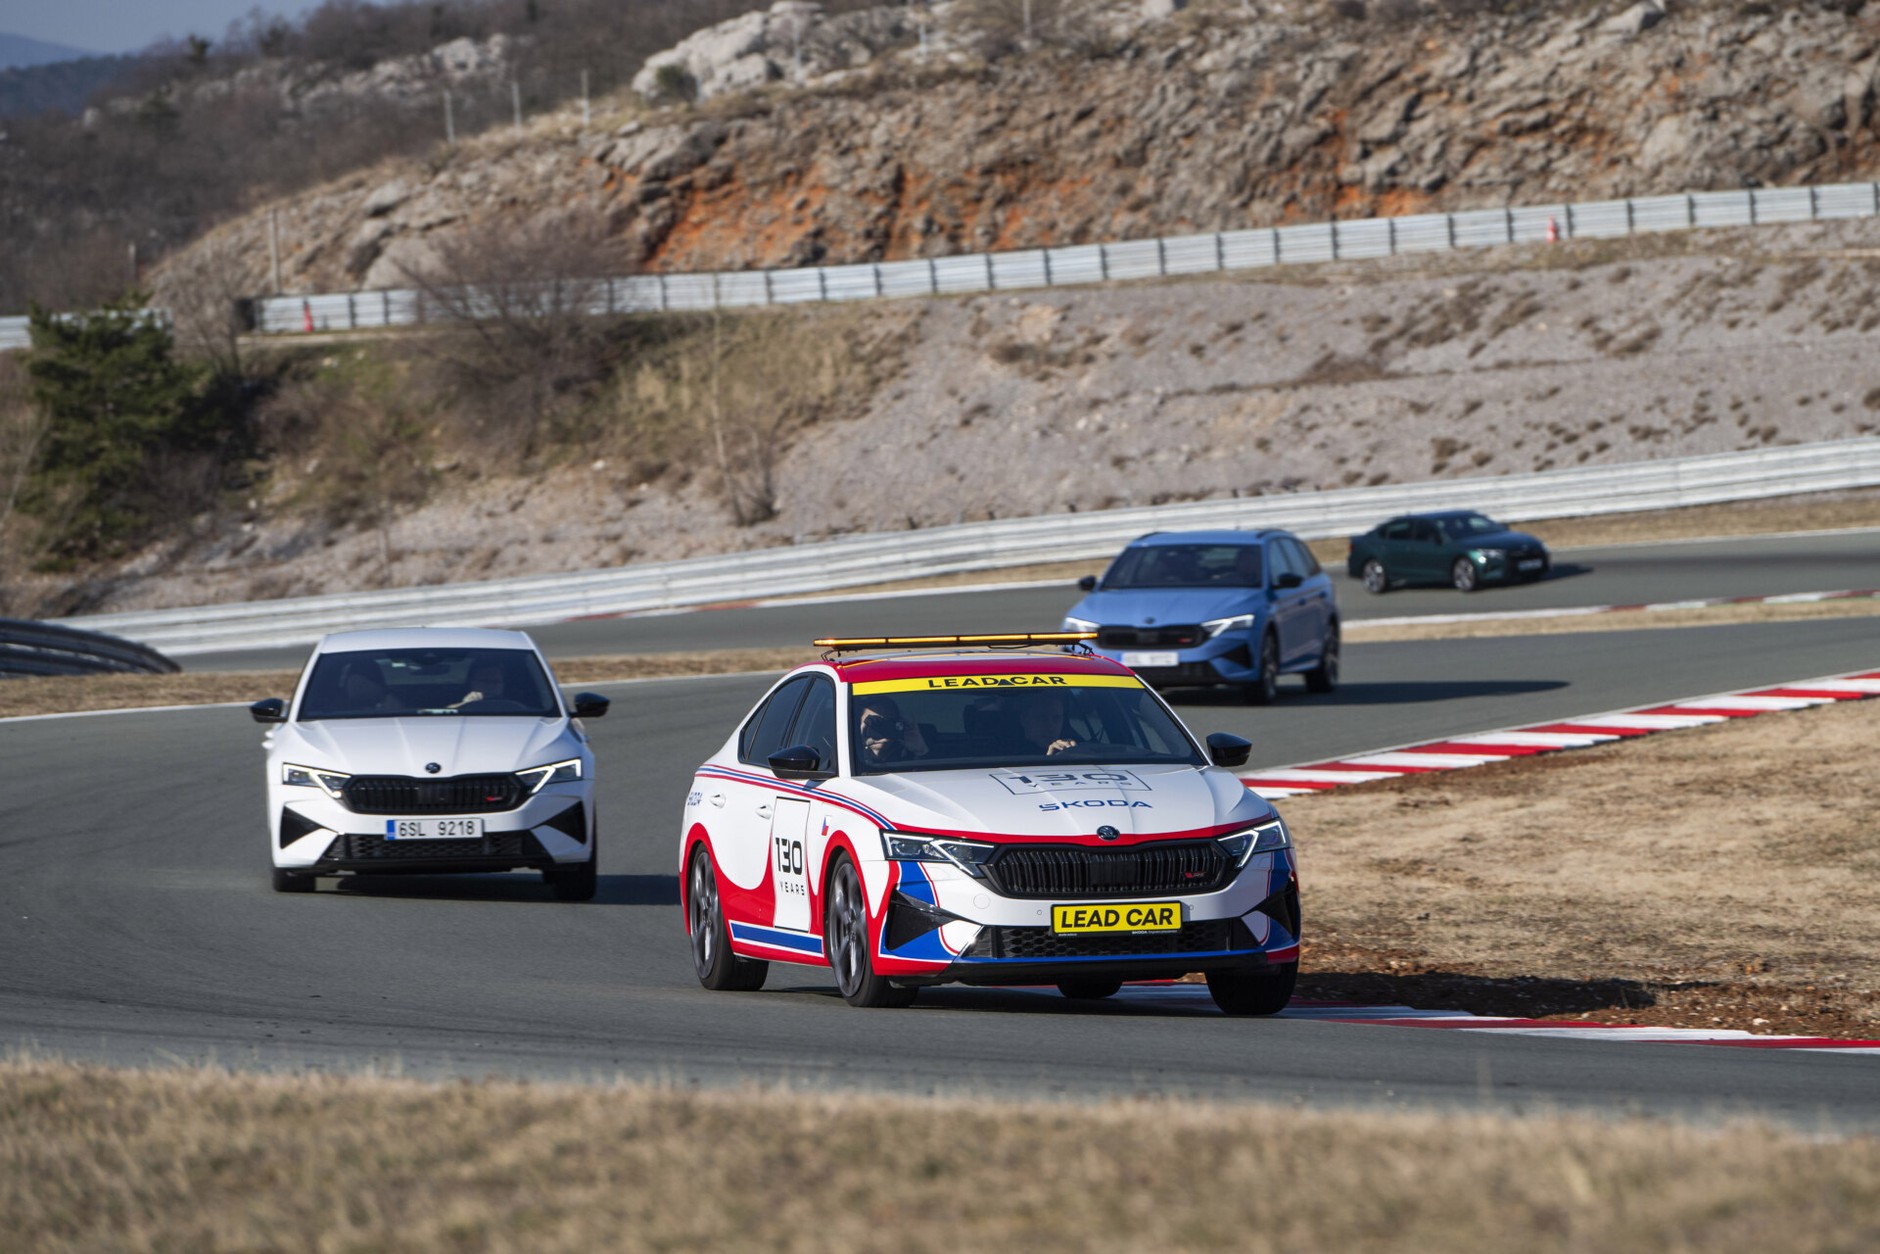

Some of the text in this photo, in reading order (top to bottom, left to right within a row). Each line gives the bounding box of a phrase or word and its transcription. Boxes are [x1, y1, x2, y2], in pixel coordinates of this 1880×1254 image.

[928, 676, 1067, 688] LEAD CAR
[1008, 773, 1129, 784] 130
[399, 820, 475, 836] 6SL 9218
[775, 837, 803, 875] 130
[780, 881, 805, 896] YEARS
[1061, 908, 1173, 928] LEAD CAR
